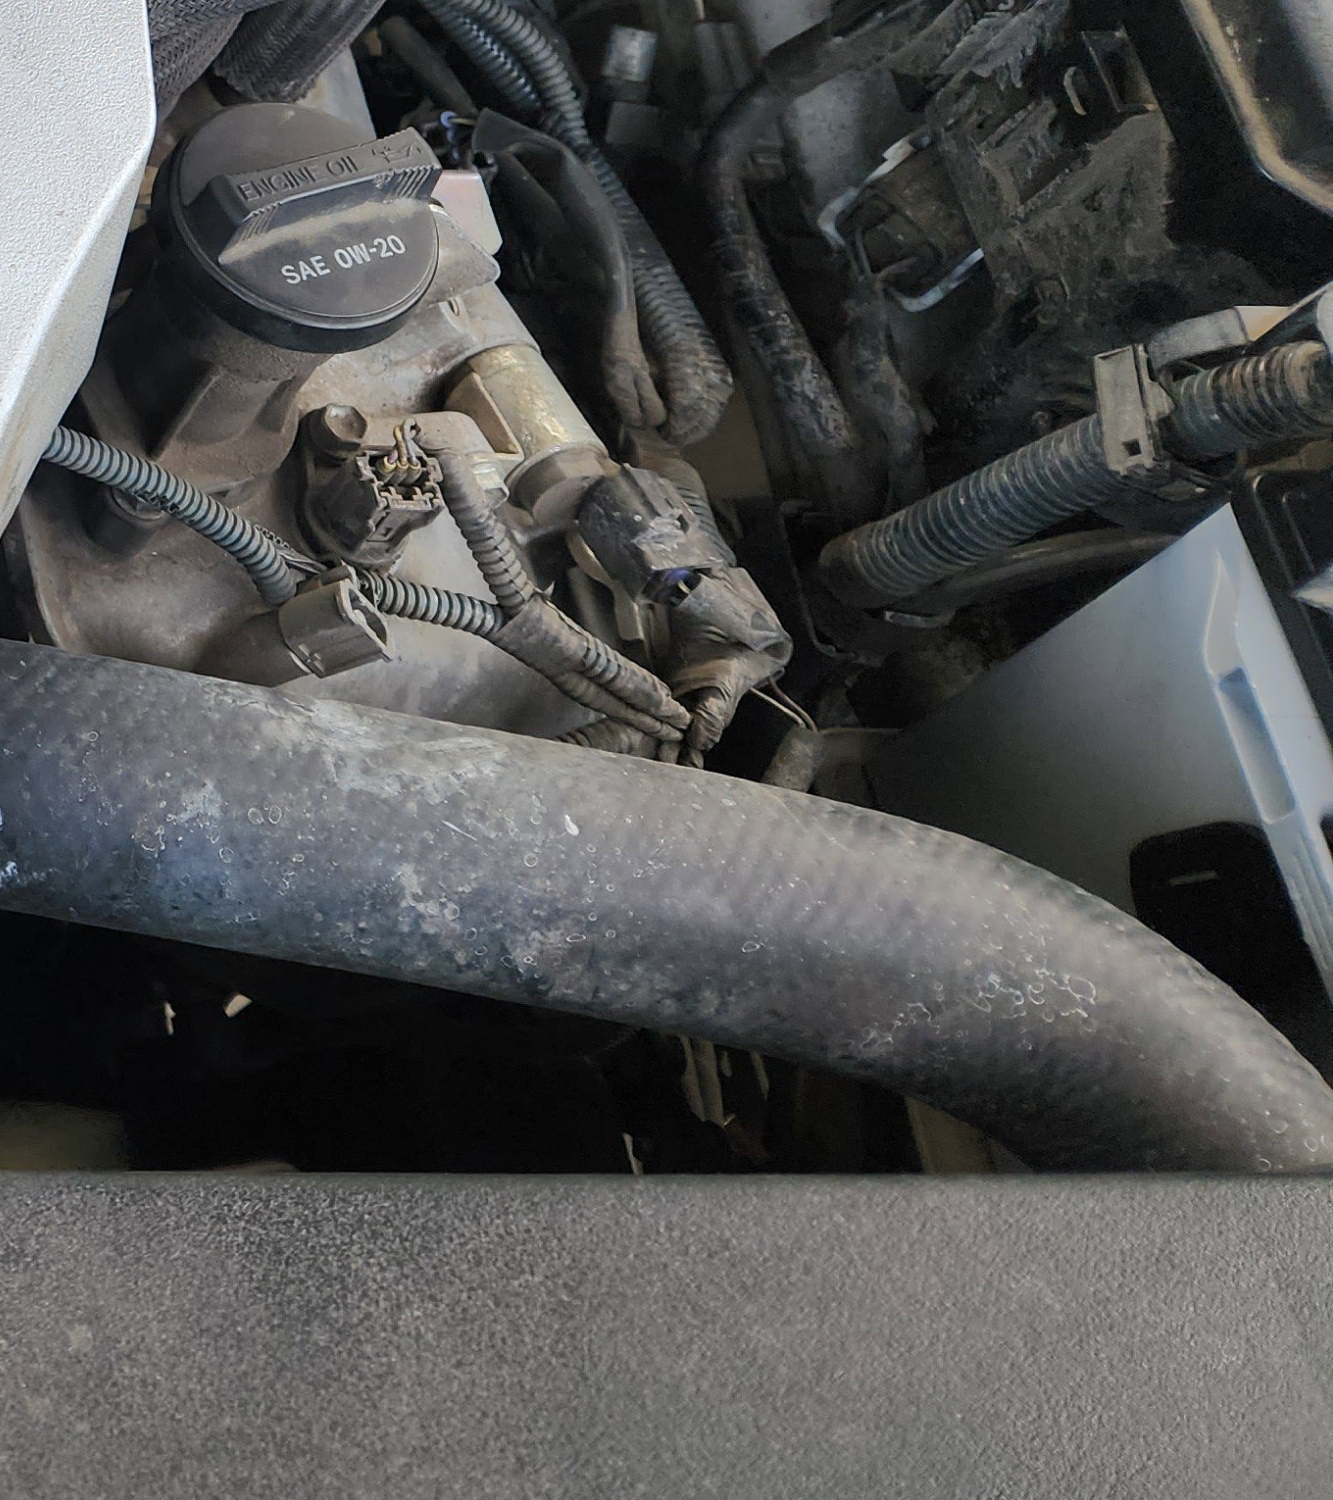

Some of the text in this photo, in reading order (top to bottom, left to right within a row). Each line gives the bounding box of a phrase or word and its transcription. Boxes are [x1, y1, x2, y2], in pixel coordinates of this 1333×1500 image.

[237, 155, 358, 201] ENGINE OIL
[281, 235, 406, 285] SAE 0W-20
